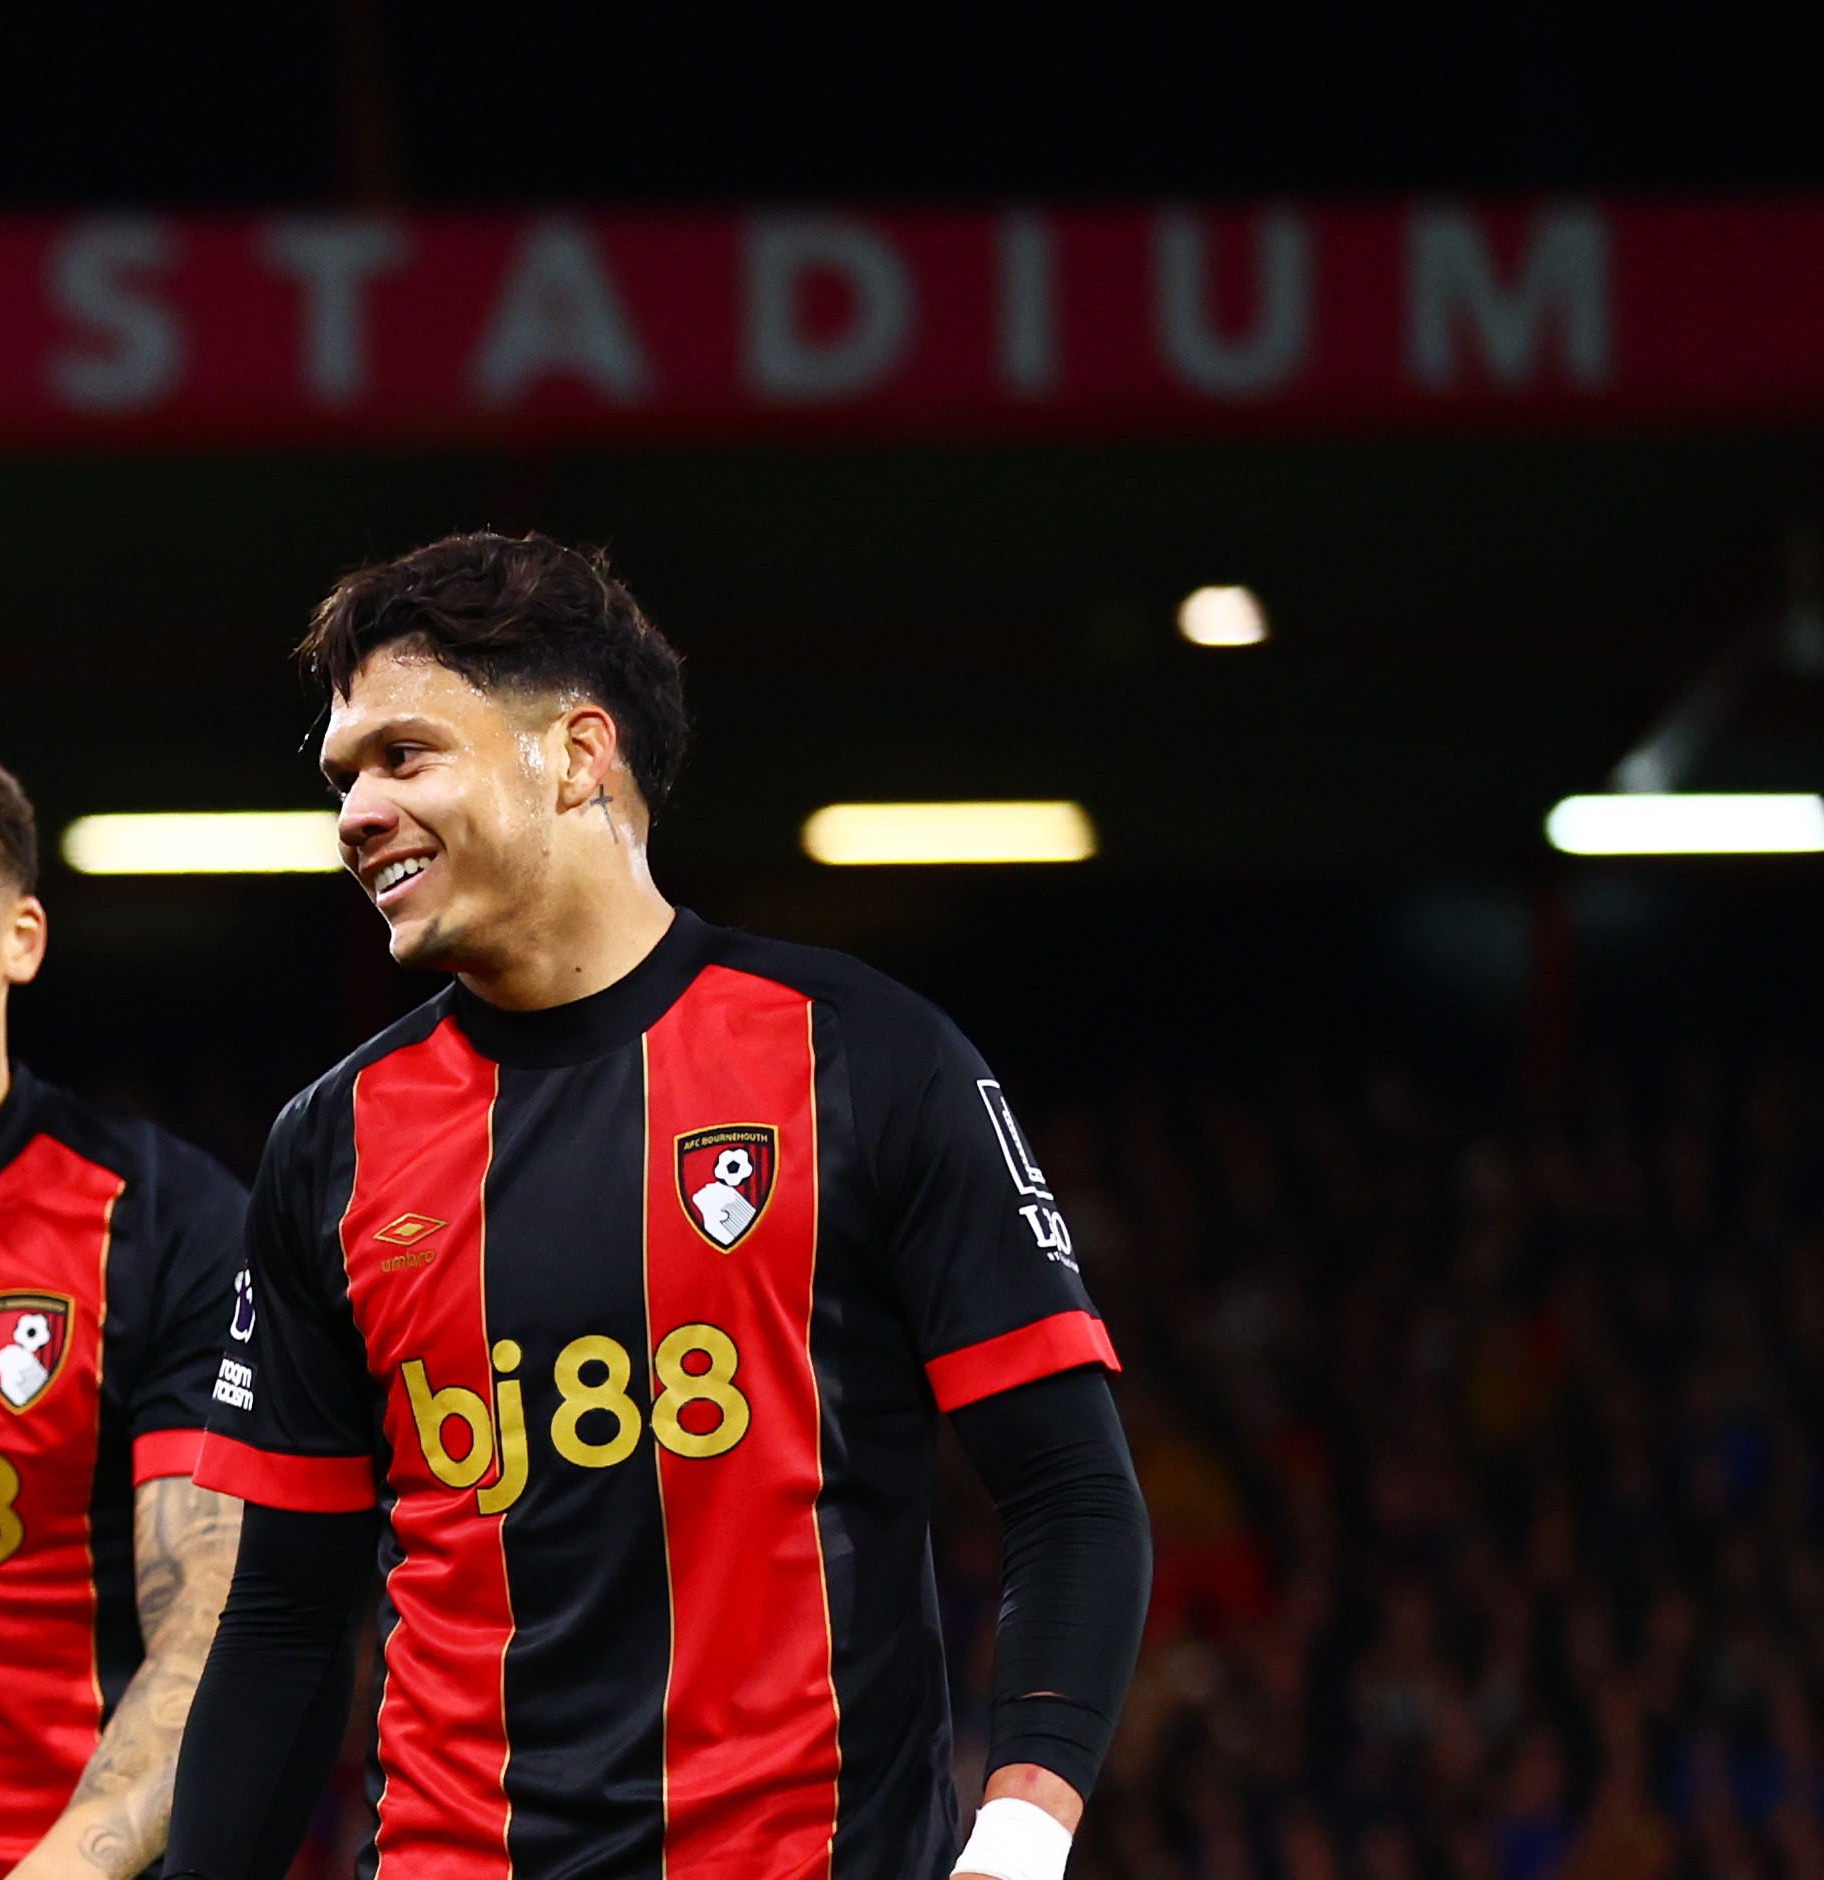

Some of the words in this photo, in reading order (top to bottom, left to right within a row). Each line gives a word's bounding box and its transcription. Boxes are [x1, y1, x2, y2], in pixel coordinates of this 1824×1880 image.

[49, 215, 1617, 402] STADIUM
[683, 1137, 701, 1151] AFC
[700, 1131, 769, 1147] BOURNEMOUTH
[381, 1249, 436, 1274] umbro
[400, 1323, 751, 1515] bj88
